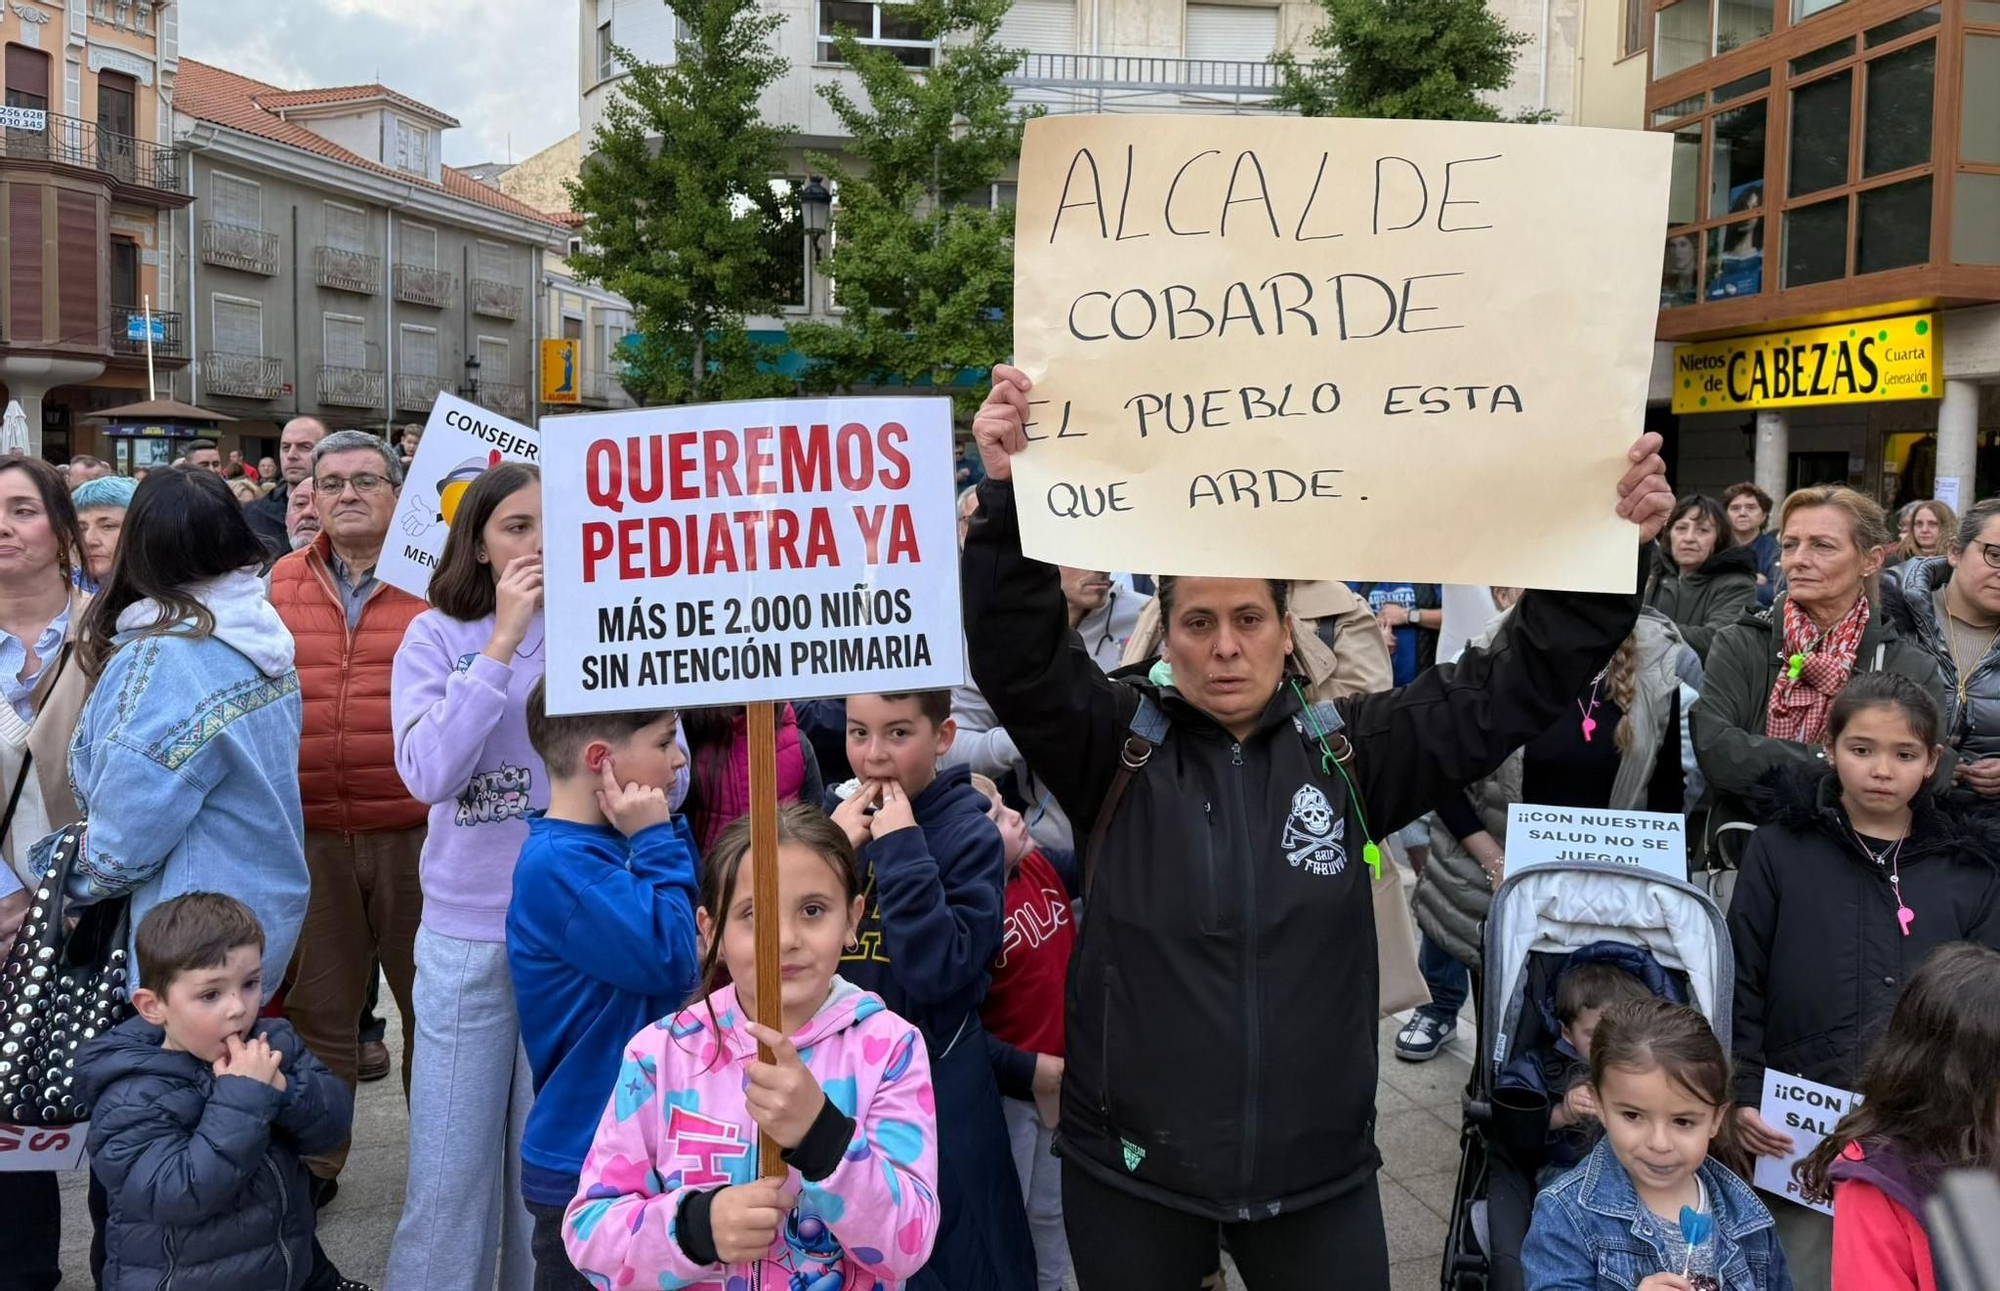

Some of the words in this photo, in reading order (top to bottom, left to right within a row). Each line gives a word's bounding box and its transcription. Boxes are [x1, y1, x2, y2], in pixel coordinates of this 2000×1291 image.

[23, 110, 43, 120] 628
[23, 119, 43, 129] 345
[1050, 144, 1503, 243] ALCALDE
[1069, 272, 1466, 341] COBARDE
[1679, 353, 1726, 373] Nietos
[1727, 337, 1879, 403] CABEZAS
[1885, 347, 1926, 363] Cuarta
[1704, 374, 1724, 392] de
[1884, 368, 1928, 386] Generación
[1022, 400, 1089, 441] EL
[1124, 382, 1341, 438] PUEBLO
[1383, 384, 1524, 416] ESTA
[445, 410, 540, 463] CONSEJER
[586, 422, 911, 513] QUEREMOS
[1047, 481, 1135, 519] QUE
[1189, 468, 1369, 509] ARDE.
[404, 544, 439, 570] MEN
[582, 506, 840, 583] PEDIATRA
[853, 503, 922, 565] YA
[598, 596, 667, 644] MÁS
[676, 600, 715, 638] DE
[723, 595, 812, 634] 2.000
[821, 583, 912, 627] NIÑOS
[582, 654, 629, 691] SIN
[638, 637, 782, 687] ATENCIÓN
[791, 633, 932, 676] PRIMARIA
[455, 791, 536, 827] ANGEL
[1518, 811, 1573, 825] ¡¡CON
[1581, 815, 1681, 832] NUESTRA
[1528, 830, 1597, 844] SALUD
[1605, 835, 1635, 848] NO
[1643, 838, 1670, 851] SE
[995, 888, 1069, 968] FILA
[1775, 1083, 1842, 1113] ¡¡CON
[1785, 1112, 1831, 1136] SAL
